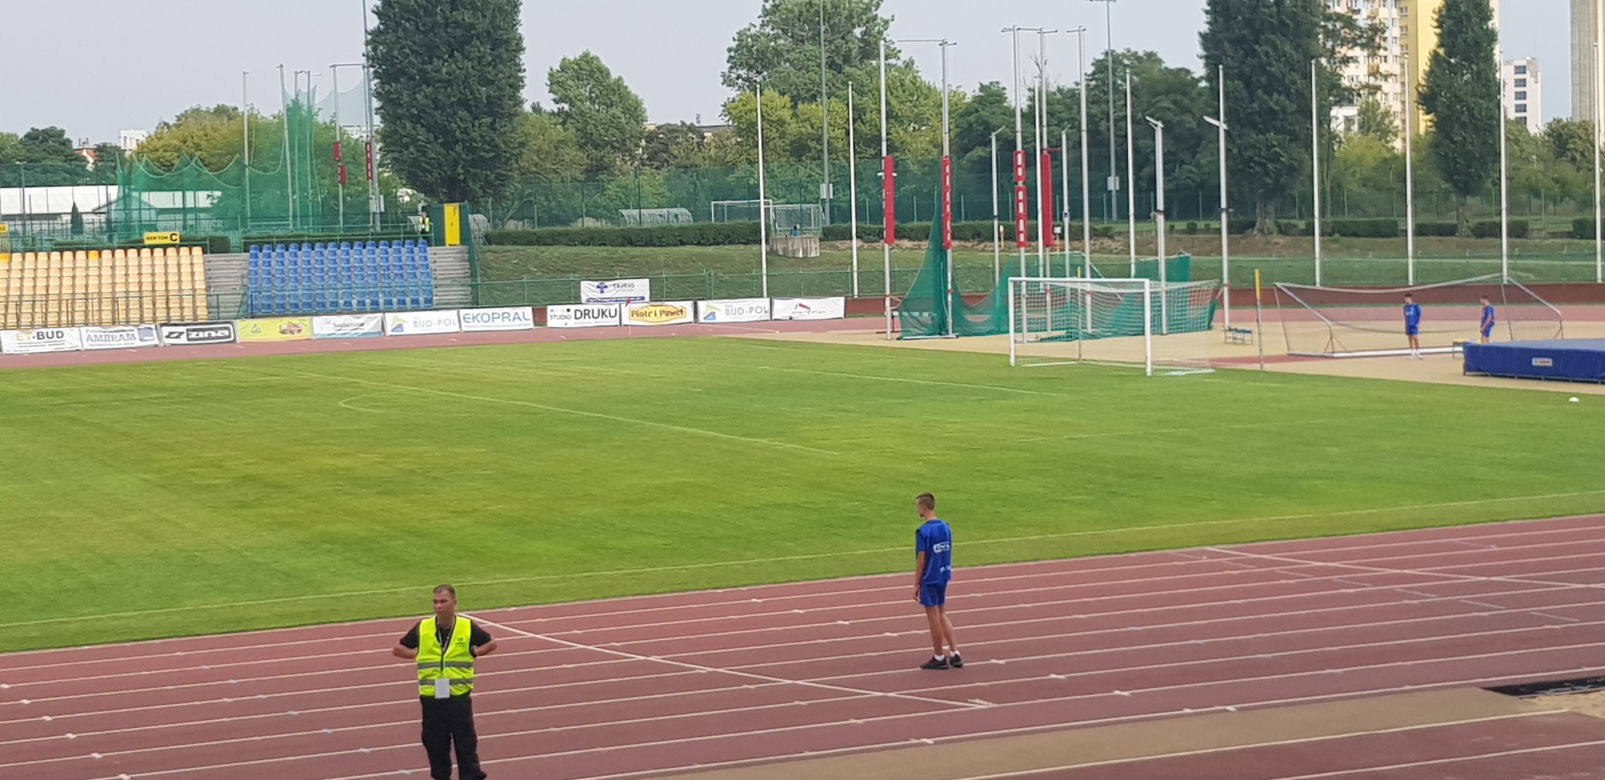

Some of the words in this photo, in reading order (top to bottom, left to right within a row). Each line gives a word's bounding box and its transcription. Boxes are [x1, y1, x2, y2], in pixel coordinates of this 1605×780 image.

[170, 233, 178, 241] C
[462, 311, 530, 324] EKOPRAL
[574, 308, 617, 320] DRUKU
[631, 309, 653, 318] Piotr
[85, 333, 137, 343] AMBRAM
